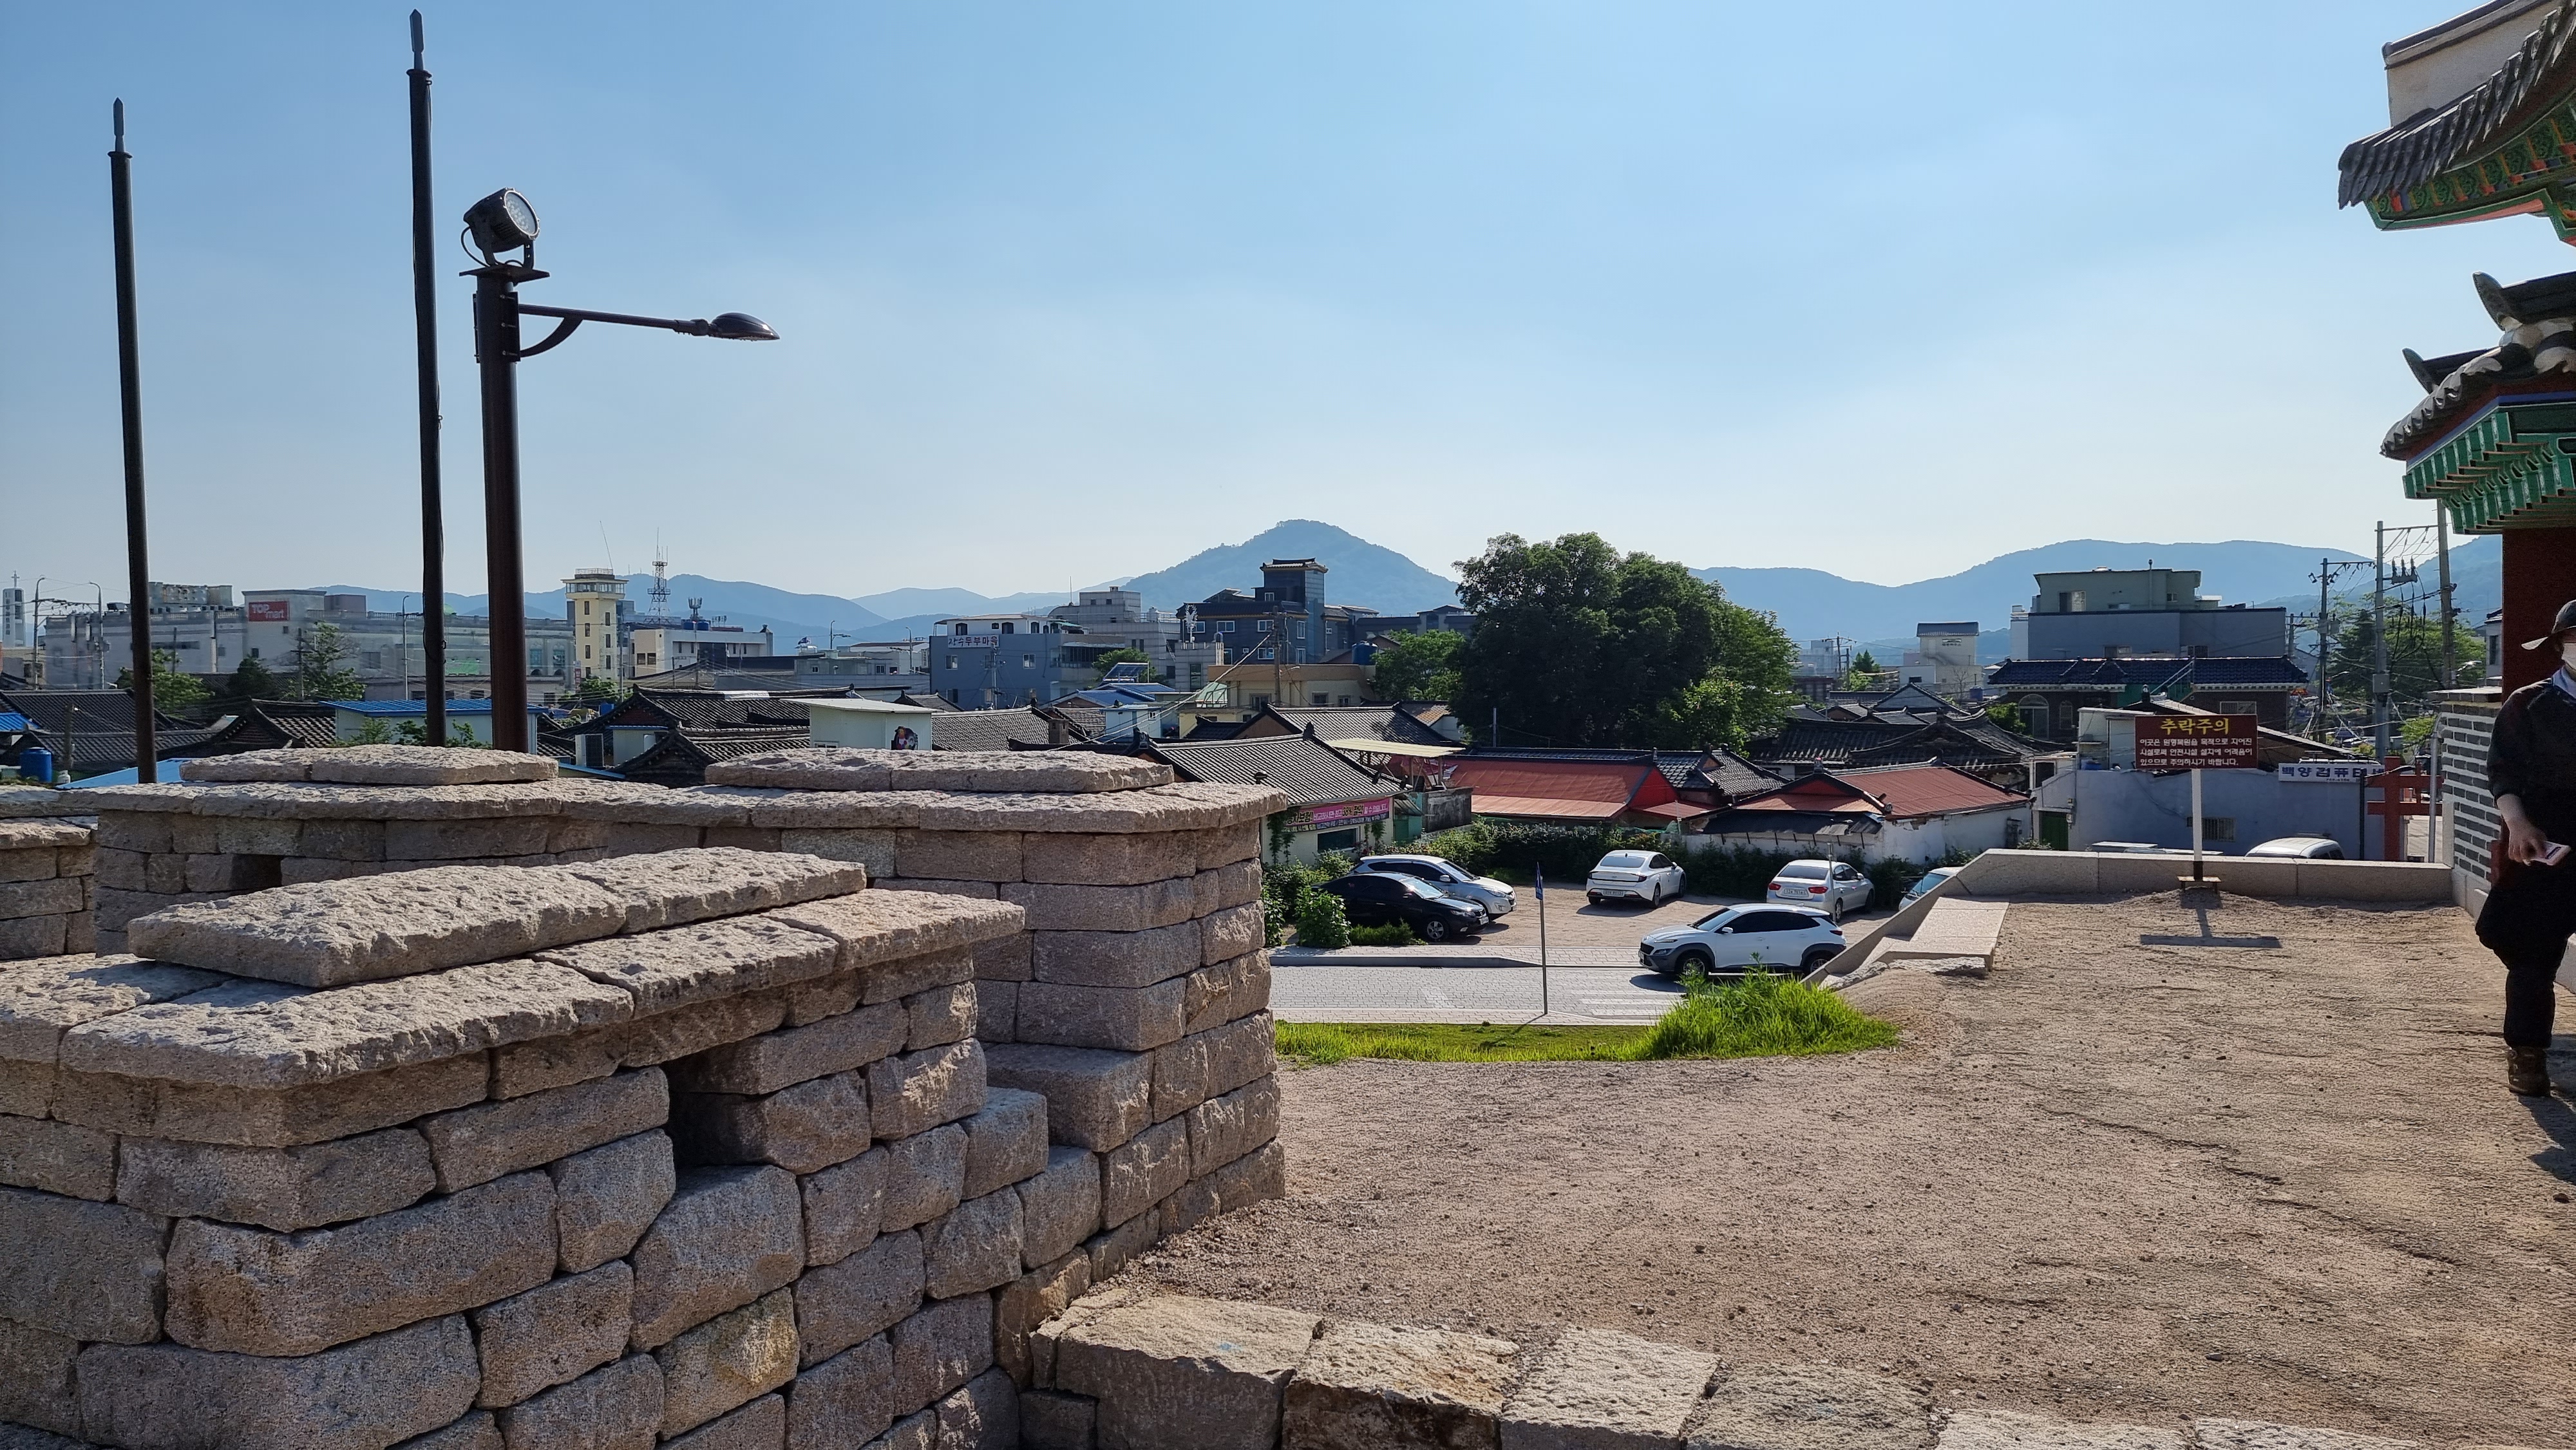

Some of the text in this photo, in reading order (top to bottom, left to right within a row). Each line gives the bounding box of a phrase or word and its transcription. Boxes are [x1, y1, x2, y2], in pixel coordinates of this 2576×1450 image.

[252, 604, 269, 614] TOP
[265, 609, 285, 618] mart
[2160, 717, 2230, 735] 추락주의
[2224, 748, 2253, 756] 어려움이
